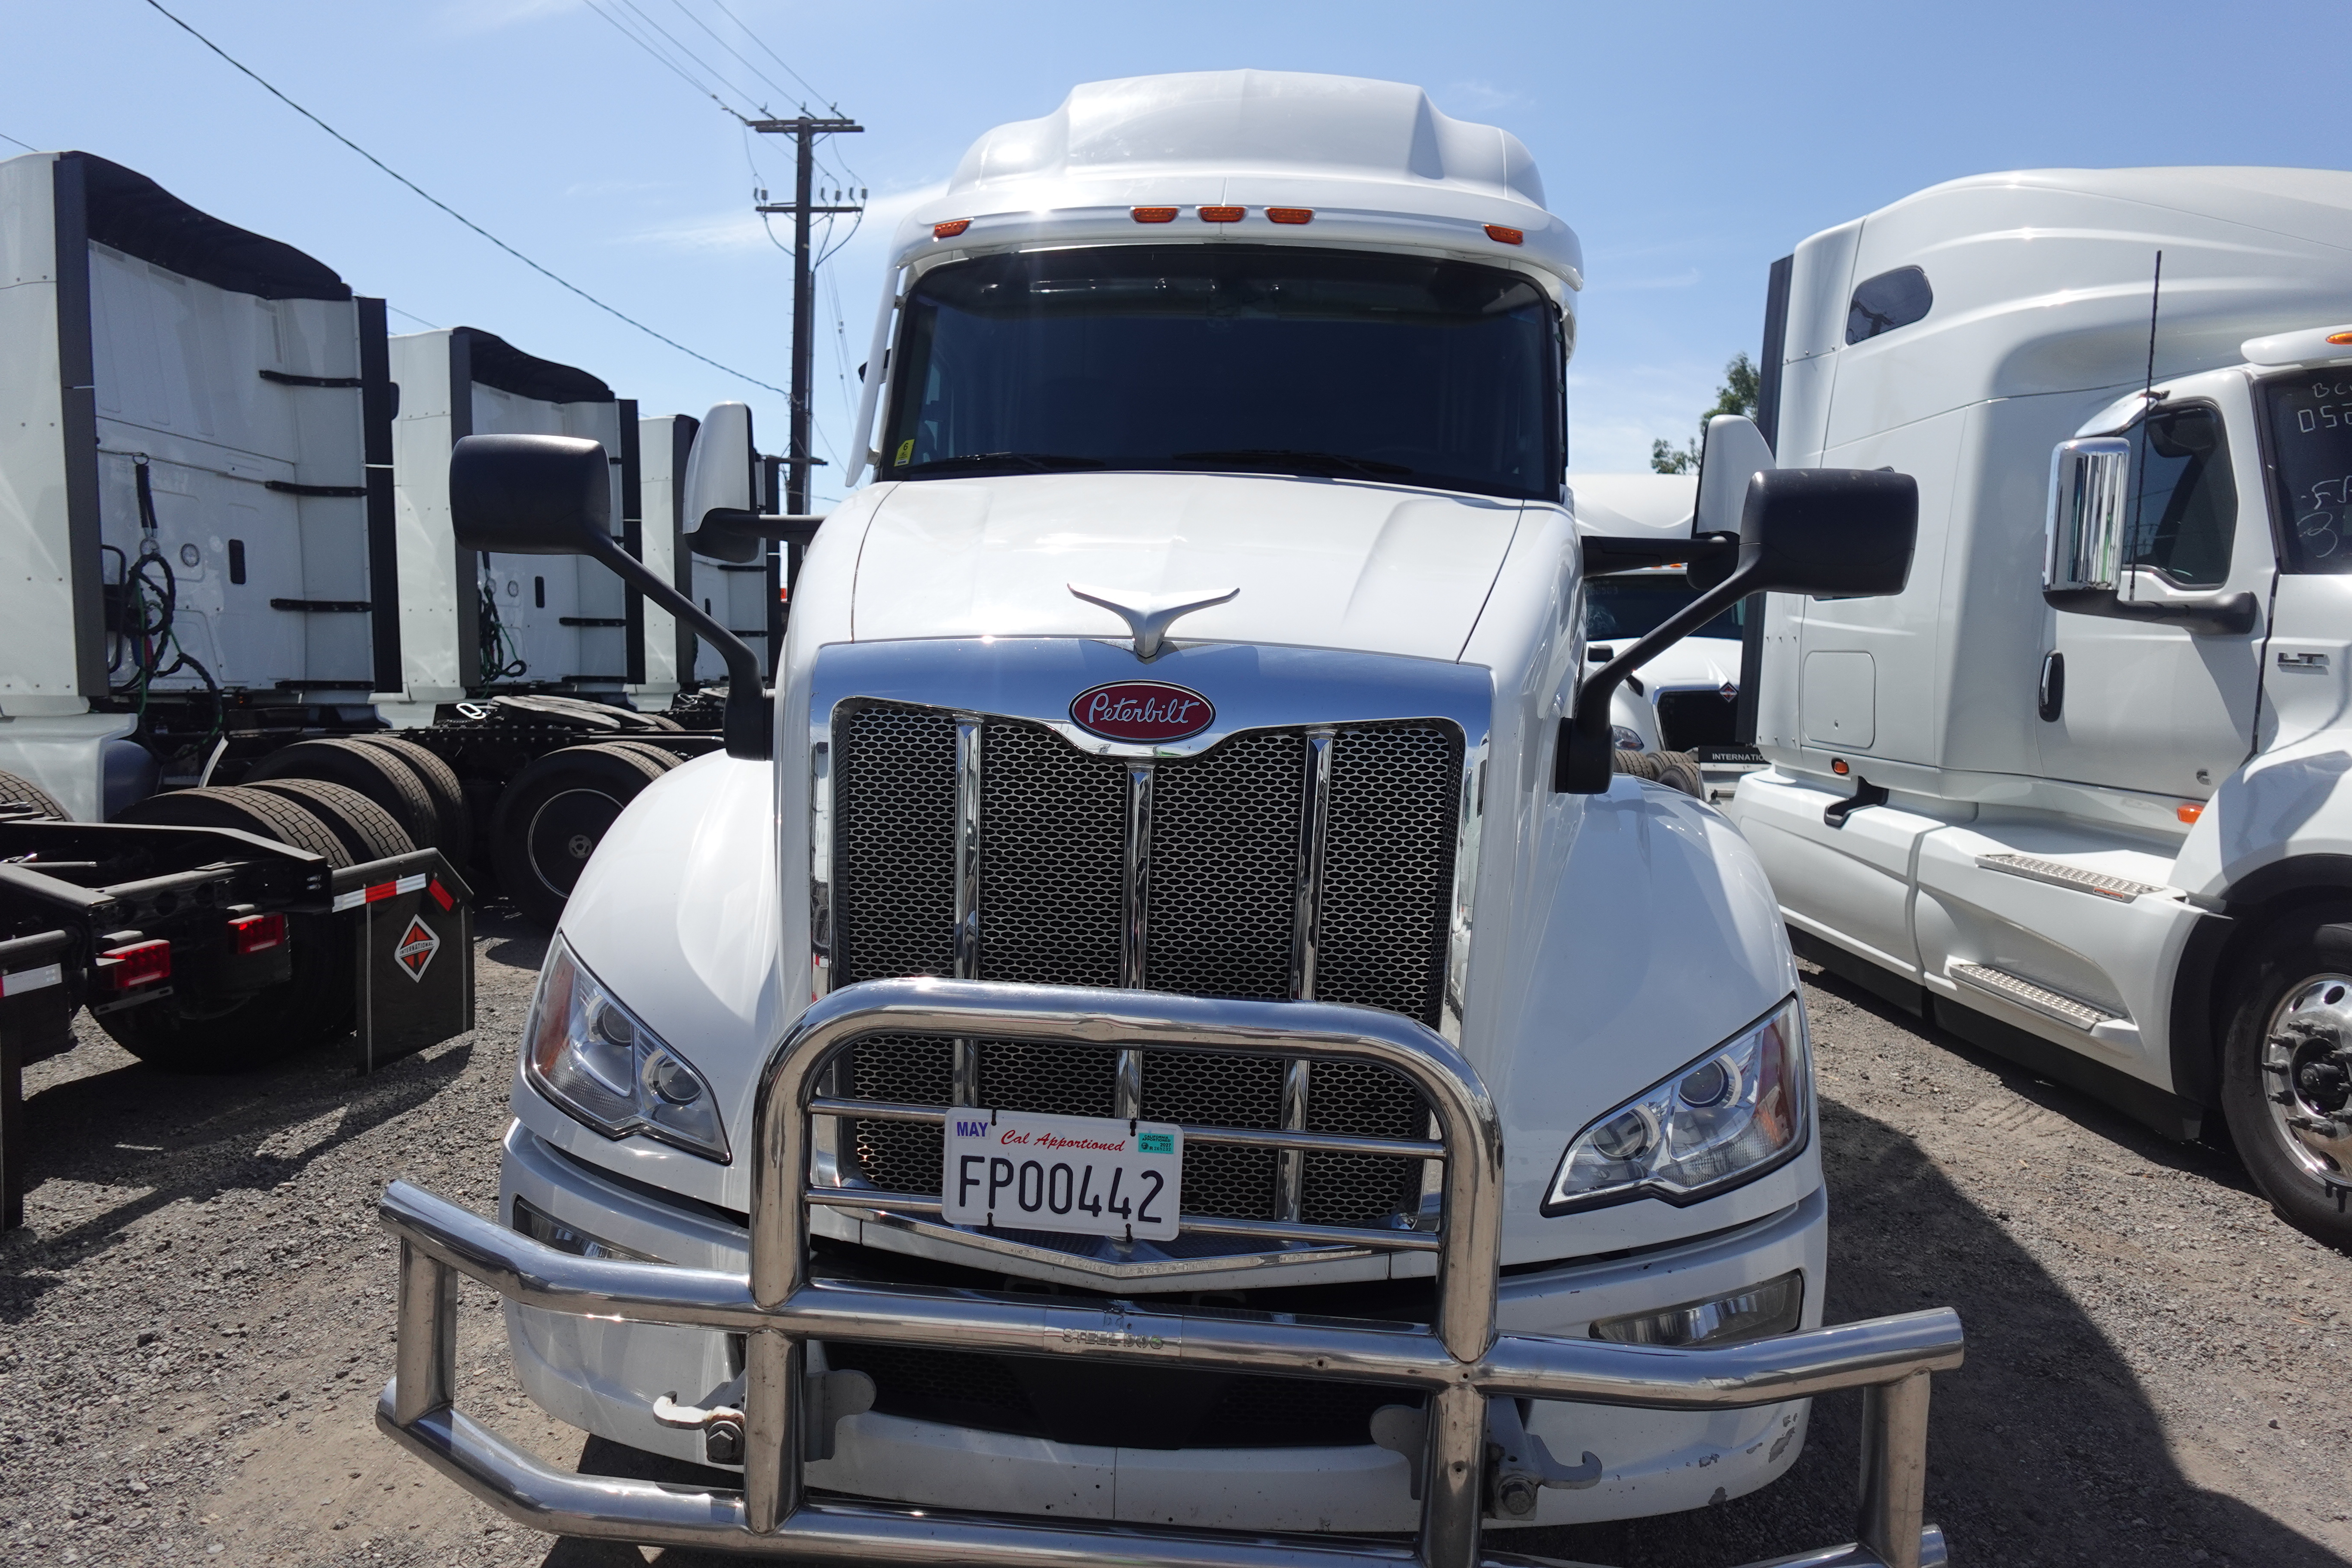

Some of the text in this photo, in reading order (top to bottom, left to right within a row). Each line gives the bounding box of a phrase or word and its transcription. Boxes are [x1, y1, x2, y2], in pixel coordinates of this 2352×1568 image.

[2278, 652, 2327, 665] LT
[1088, 692, 1200, 724] Peterbilt
[399, 941, 434, 955] INTERNATIONAL
[957, 1121, 989, 1137] MAY
[1001, 1129, 1126, 1152] Cal Apportioned
[959, 1155, 1165, 1224] FP00442
[1063, 1328, 1118, 1346] STEEL
